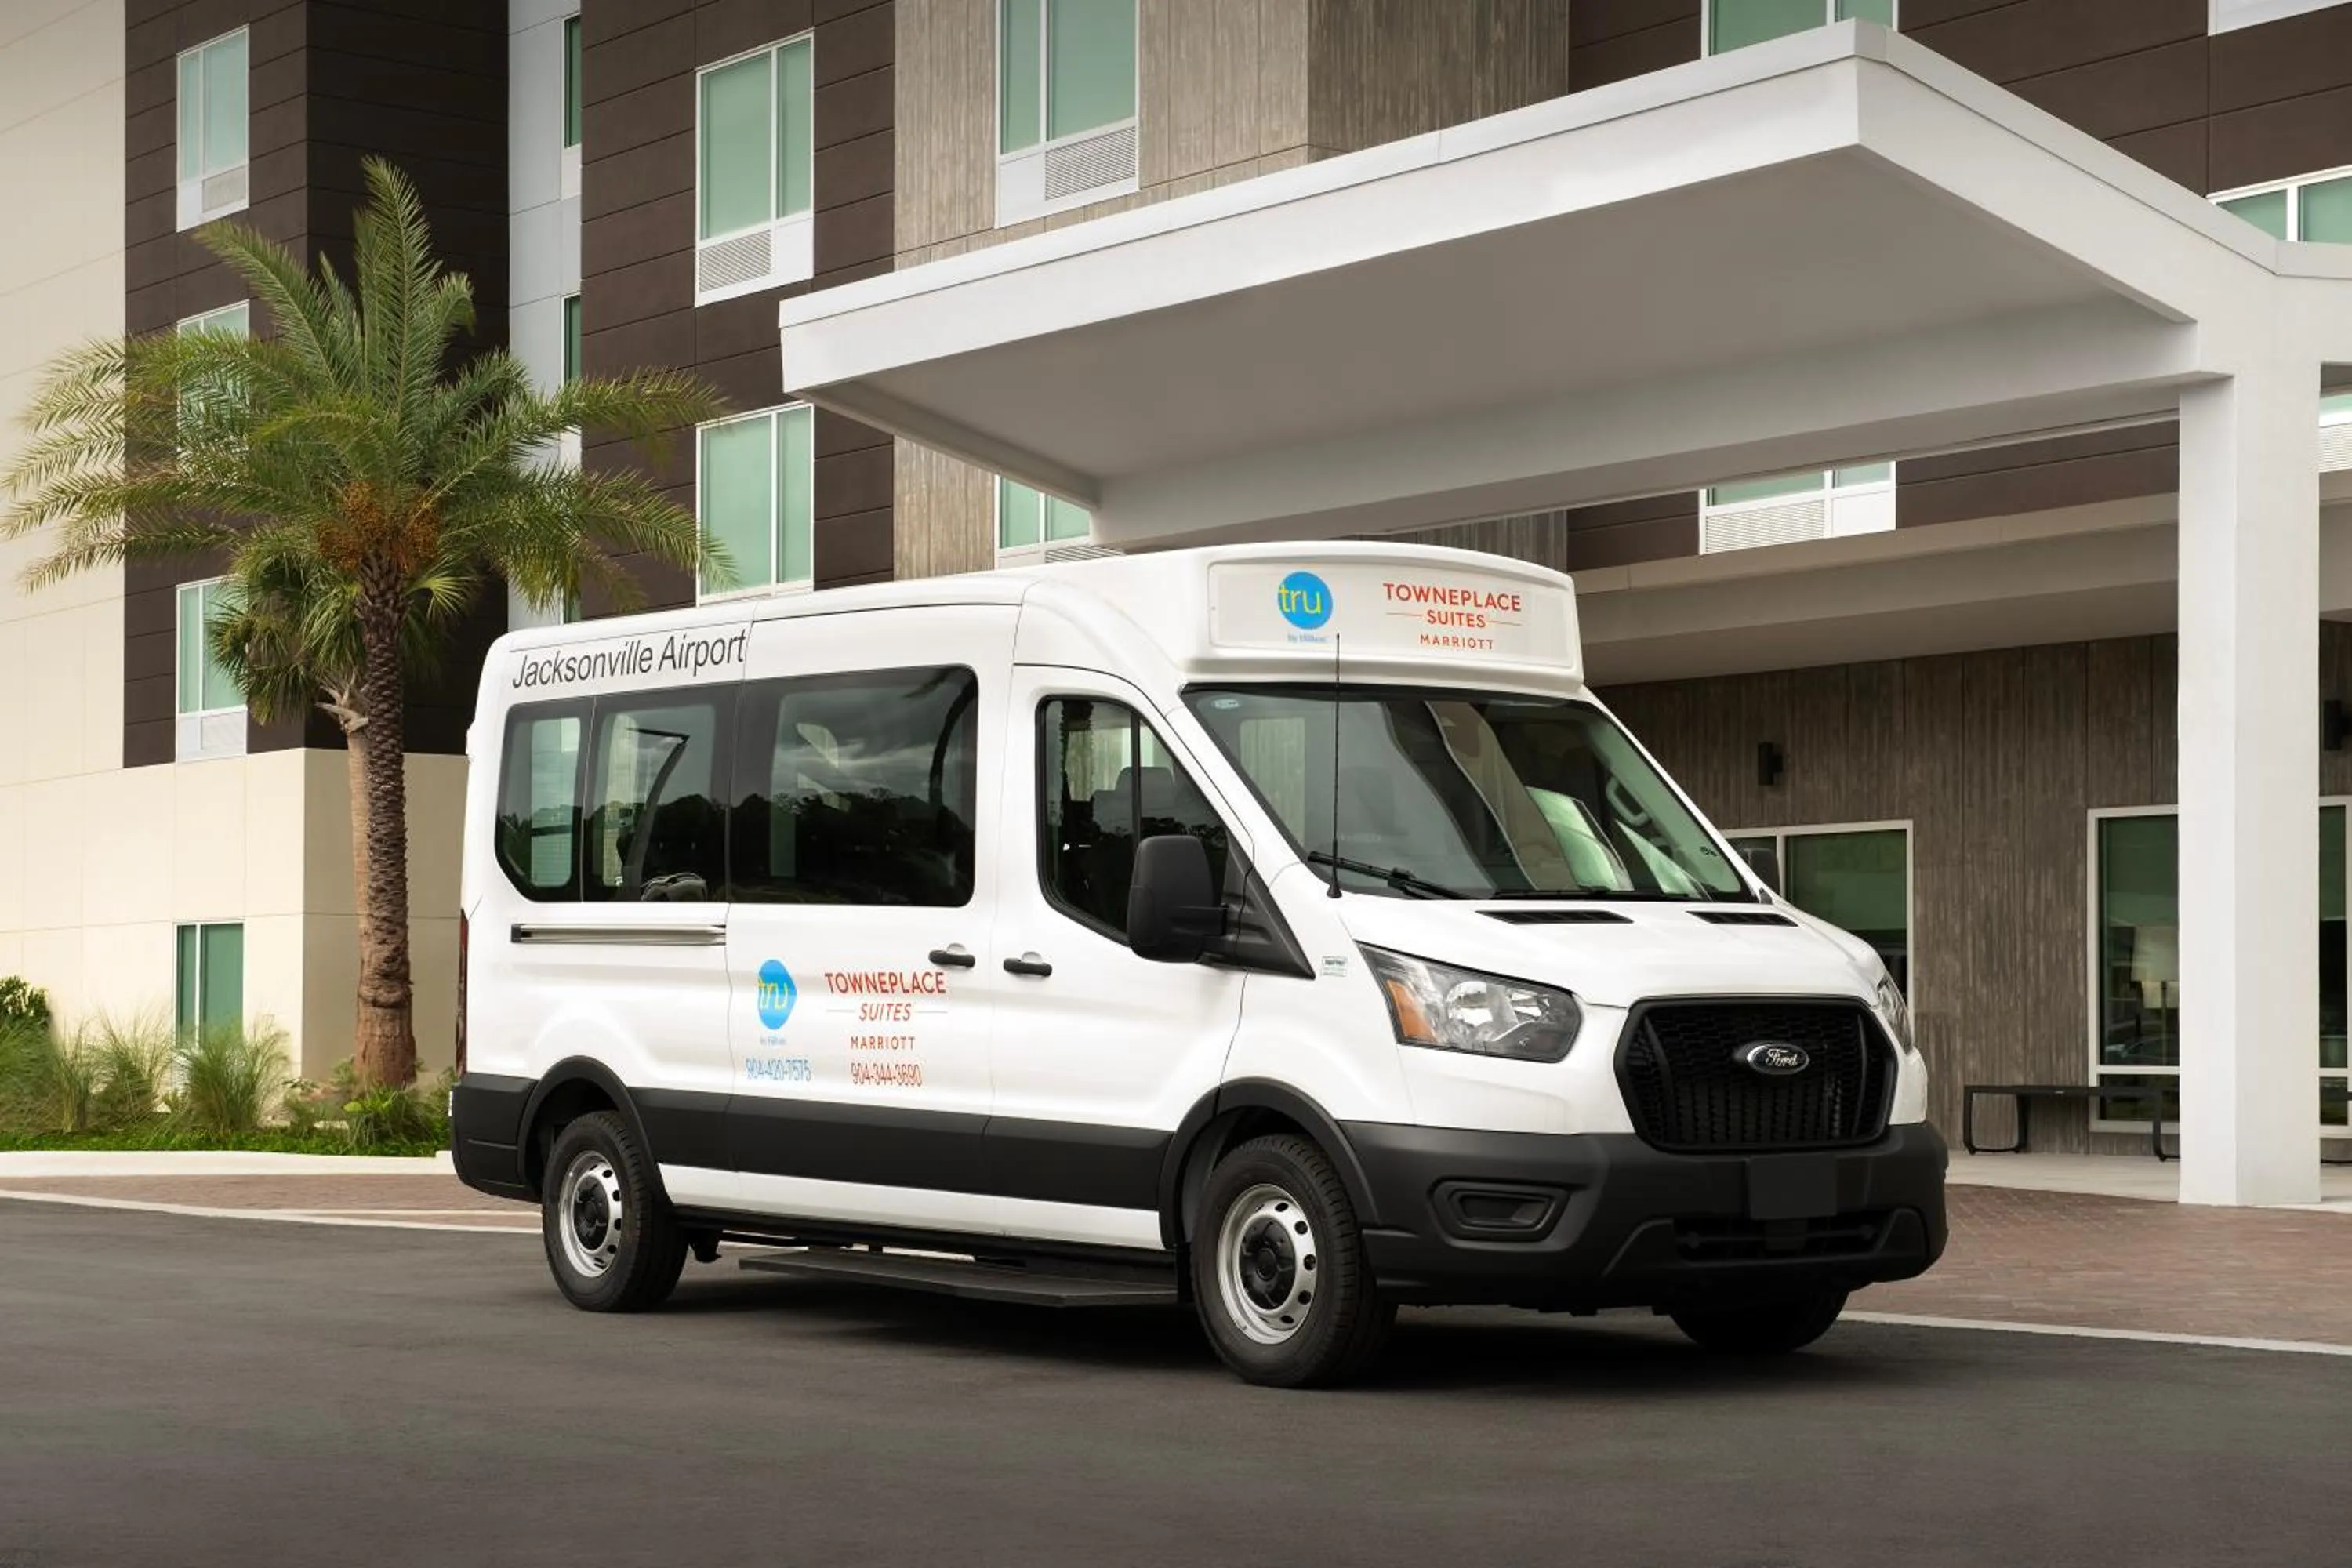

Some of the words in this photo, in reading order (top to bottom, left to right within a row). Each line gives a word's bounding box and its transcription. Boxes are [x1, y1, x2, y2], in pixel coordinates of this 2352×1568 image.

[1279, 582, 1321, 615] tru
[1383, 583, 1522, 612] TOWNEPLACE
[1427, 609, 1486, 628] SUITES
[1420, 633, 1494, 650] MARRIOTT
[512, 639, 653, 688] Jacksonville
[657, 629, 747, 677] Airport
[824, 971, 946, 994] TOWNEPLACE
[859, 1003, 912, 1022] SUITES
[851, 1036, 916, 1051] MARRIOTT
[1766, 1048, 1798, 1067] Ford
